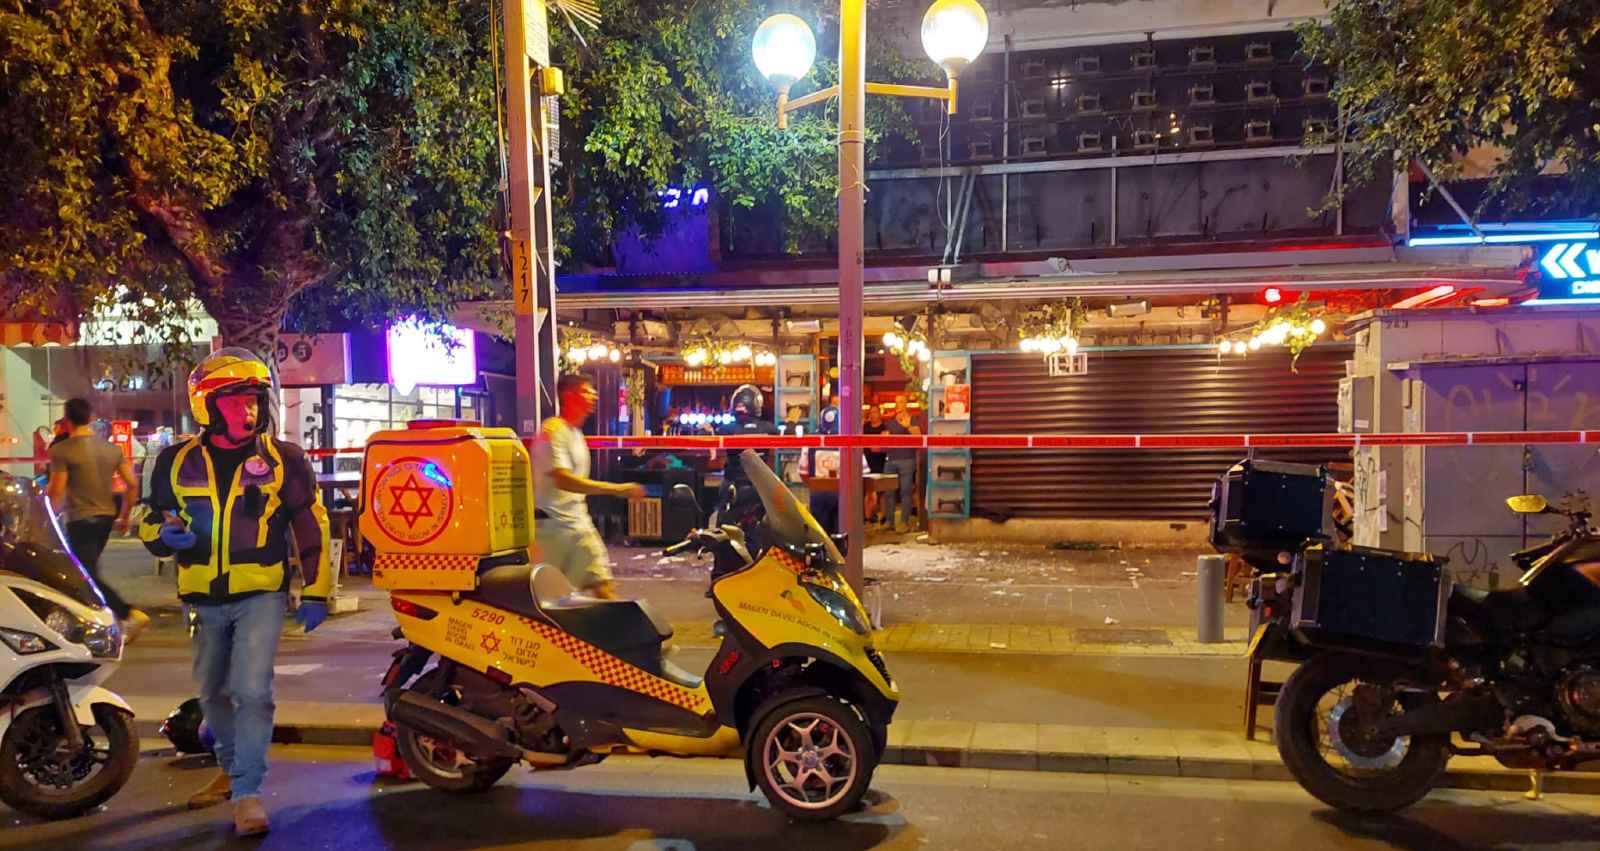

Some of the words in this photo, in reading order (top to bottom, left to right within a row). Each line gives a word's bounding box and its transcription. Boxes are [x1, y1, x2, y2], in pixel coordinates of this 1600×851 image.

[519, 241, 529, 303] 1217
[471, 607, 505, 625] 5290
[738, 601, 769, 615] MAGEN
[770, 608, 796, 623] DAVID
